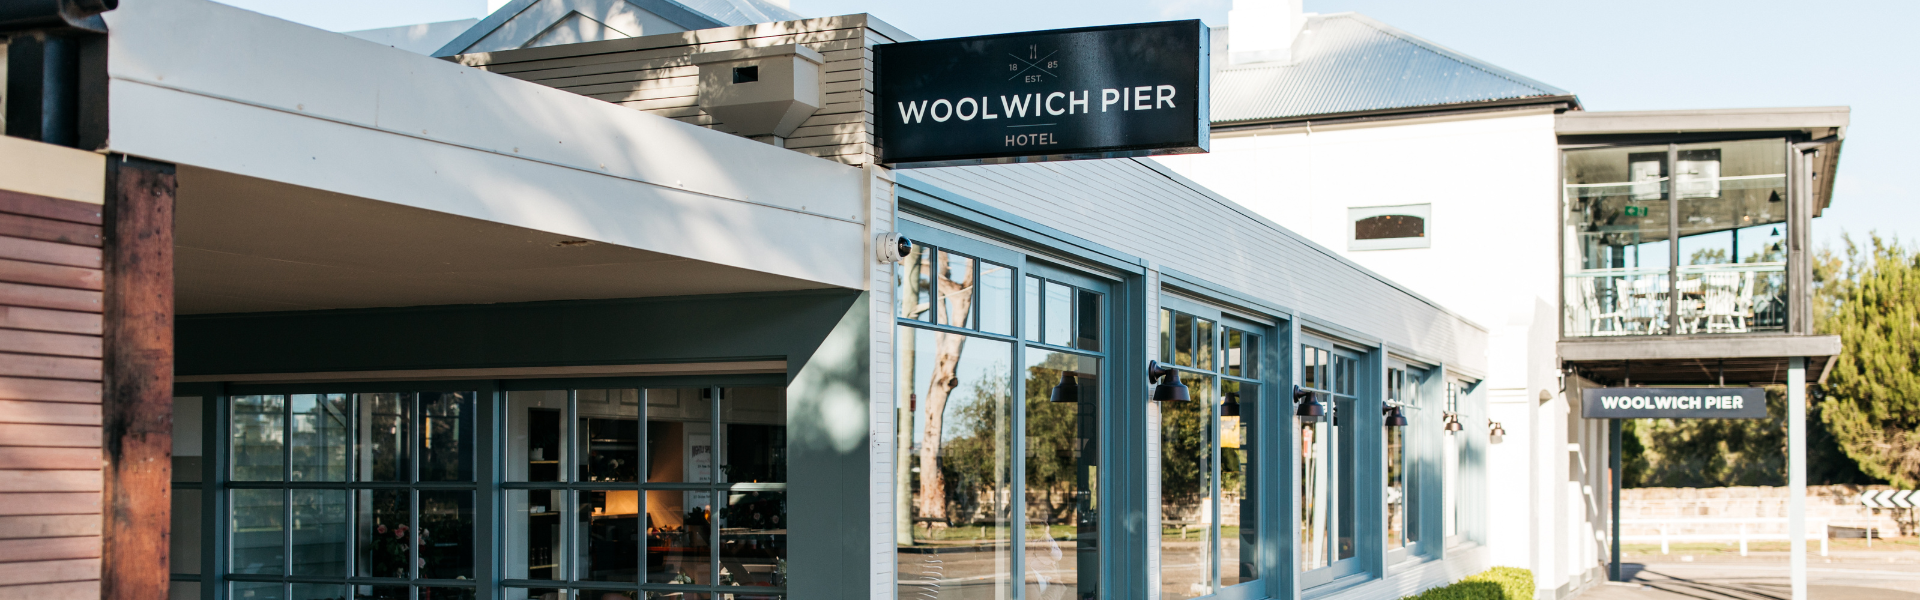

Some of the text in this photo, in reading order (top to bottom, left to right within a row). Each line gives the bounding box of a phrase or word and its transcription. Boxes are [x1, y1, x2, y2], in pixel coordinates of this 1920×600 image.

[1008, 60, 1059, 72] 18 85
[1025, 75, 1043, 84] EST.
[898, 84, 1177, 125] WOOLWICH PIER
[1005, 133, 1058, 147] HOTEL
[1601, 395, 1743, 409] WOOLWICH PIER
